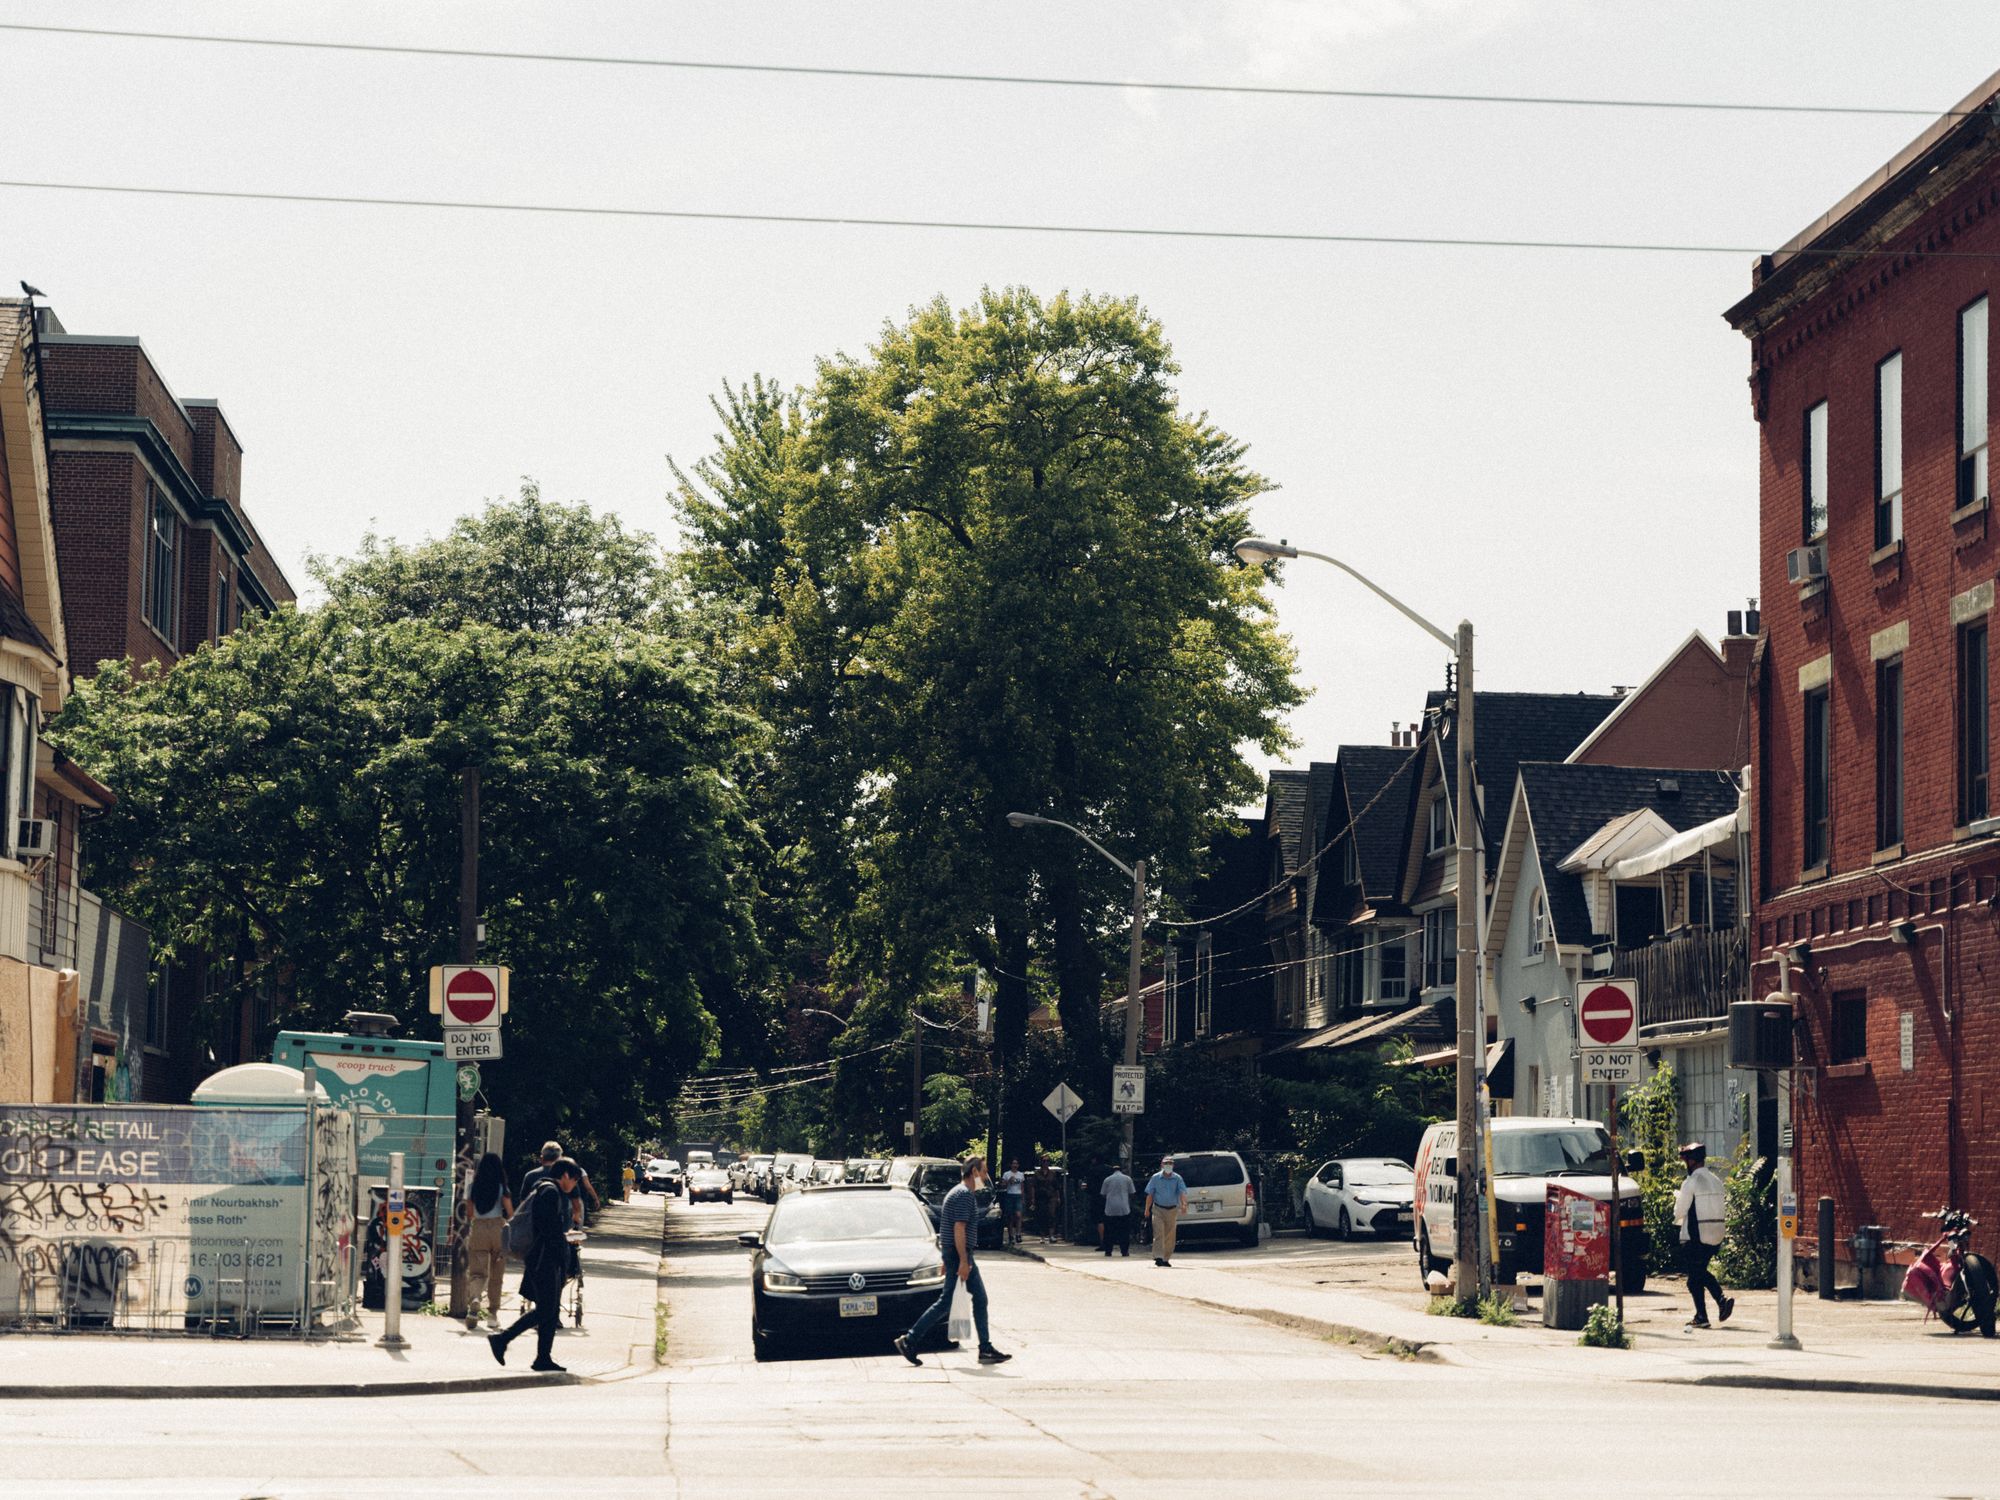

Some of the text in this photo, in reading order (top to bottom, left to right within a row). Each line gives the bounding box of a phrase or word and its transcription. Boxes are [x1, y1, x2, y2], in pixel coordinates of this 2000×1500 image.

[451, 1032, 493, 1043] DO NOT
[456, 1045, 490, 1056] ENTER
[1588, 1055, 1633, 1065] DO NOT
[337, 1061, 396, 1072] scoop truck
[1592, 1069, 1629, 1079] ENTER
[331, 1087, 397, 1115] HALO TOP
[85, 1121, 160, 1141] RETAIL
[1, 1149, 161, 1177] OR LEASE
[1429, 1183, 1454, 1204] VODKA
[181, 1197, 208, 1208] Amir
[64, 1215, 78, 1231] &
[180, 1215, 214, 1225] Jesse
